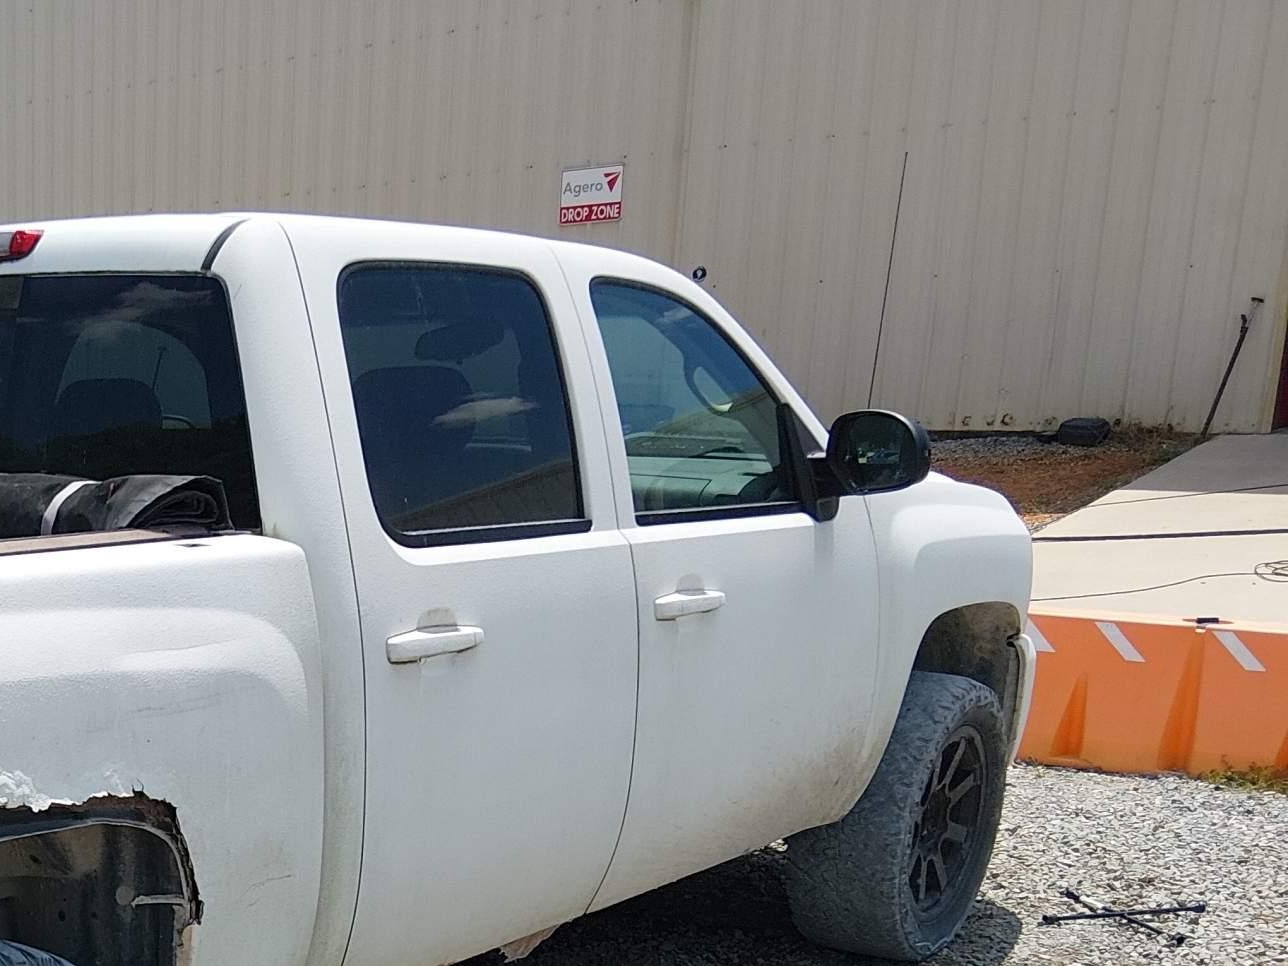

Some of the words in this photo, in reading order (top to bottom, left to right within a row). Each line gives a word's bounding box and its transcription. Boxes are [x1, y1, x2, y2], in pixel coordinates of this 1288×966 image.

[562, 181, 604, 198] Agero
[561, 207, 589, 222] DROP
[591, 204, 620, 219] ZONE
